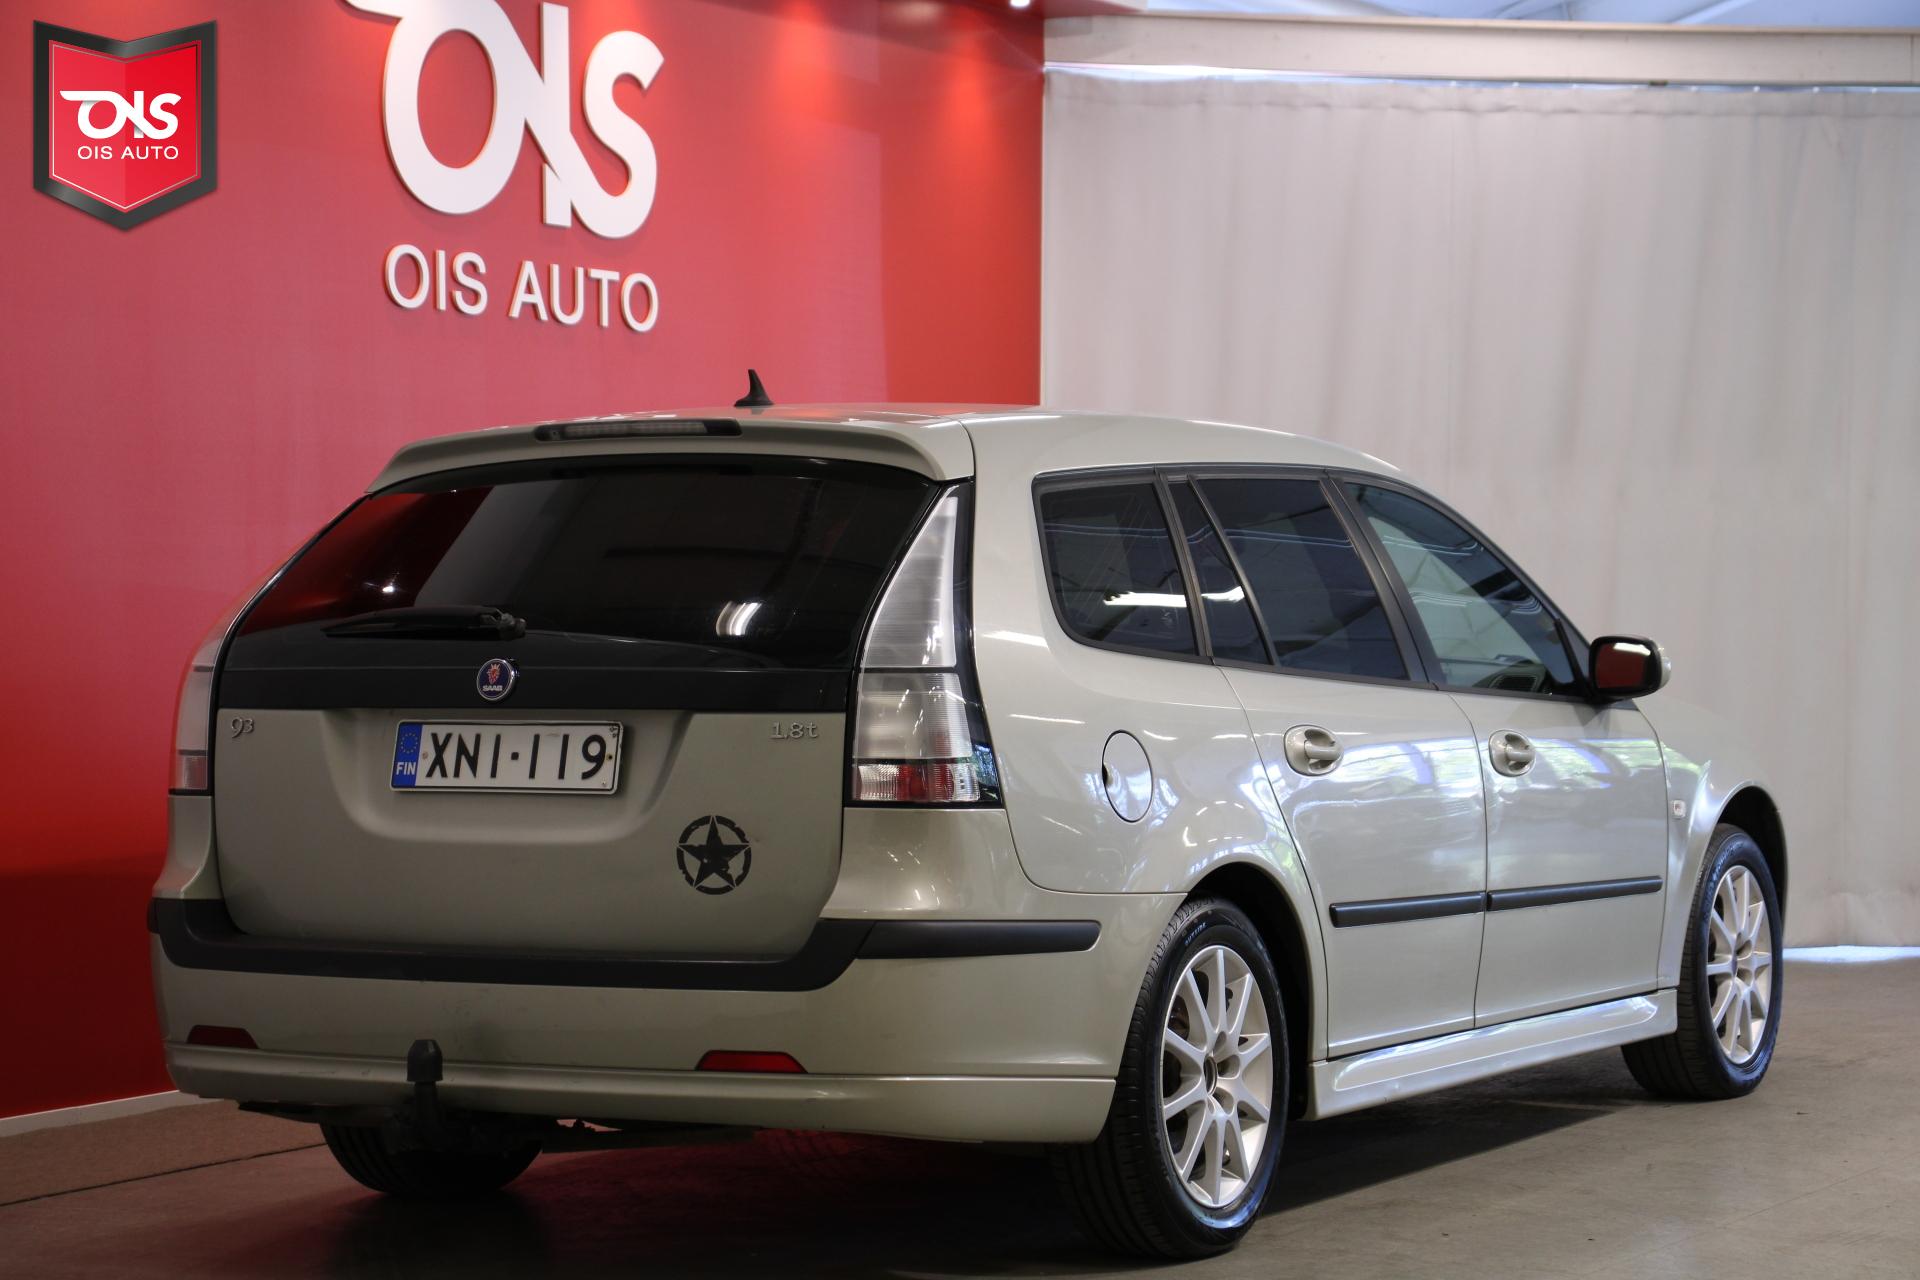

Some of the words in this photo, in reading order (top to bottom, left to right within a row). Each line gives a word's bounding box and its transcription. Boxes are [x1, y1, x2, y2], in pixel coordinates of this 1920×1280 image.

[344, 0, 665, 238] OIS
[385, 244, 488, 315] OIS
[508, 260, 659, 332] AUTO
[395, 761, 417, 776] FIN
